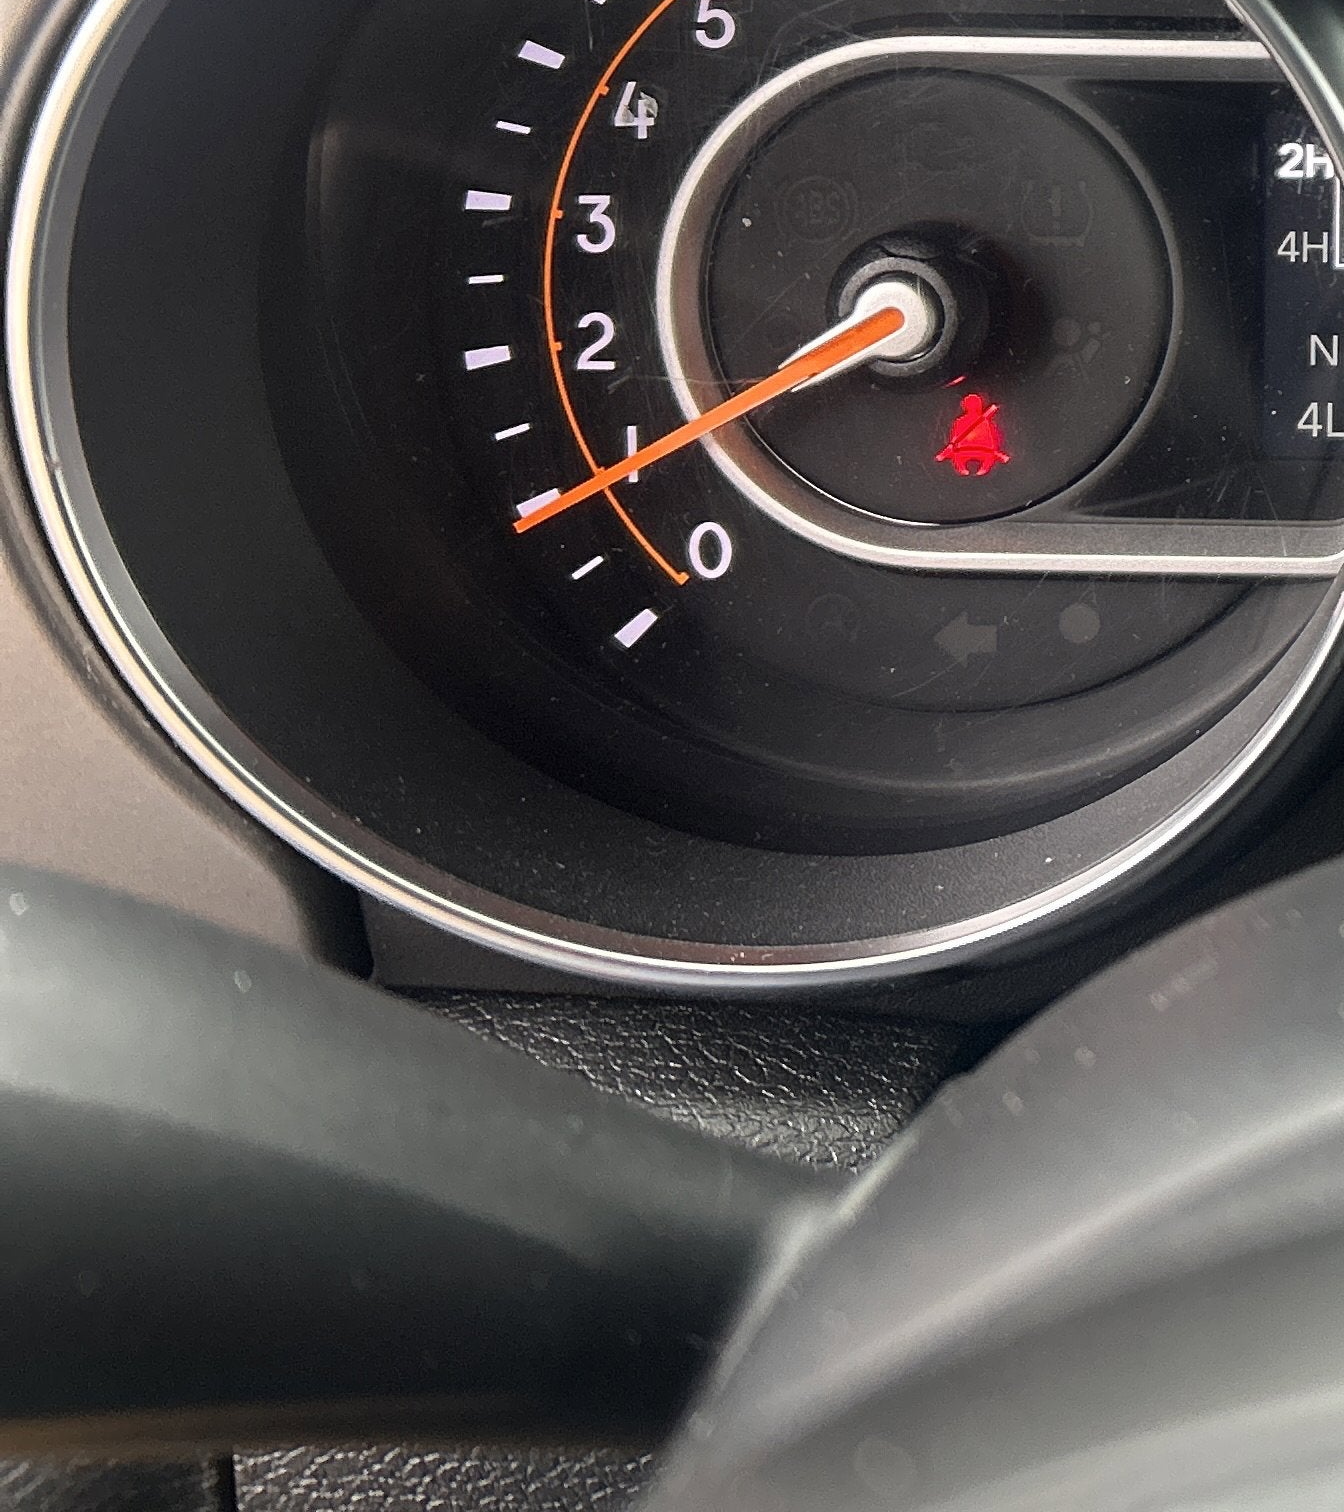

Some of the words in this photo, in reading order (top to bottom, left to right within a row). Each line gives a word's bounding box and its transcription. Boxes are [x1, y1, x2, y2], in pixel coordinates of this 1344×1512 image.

[613, 81, 658, 140] 4
[1276, 142, 1334, 179] 2H
[576, 194, 616, 254] 3
[1277, 230, 1329, 263] 4H
[576, 312, 617, 371] 2
[1310, 334, 1339, 367] N
[687, 521, 733, 580] 0
